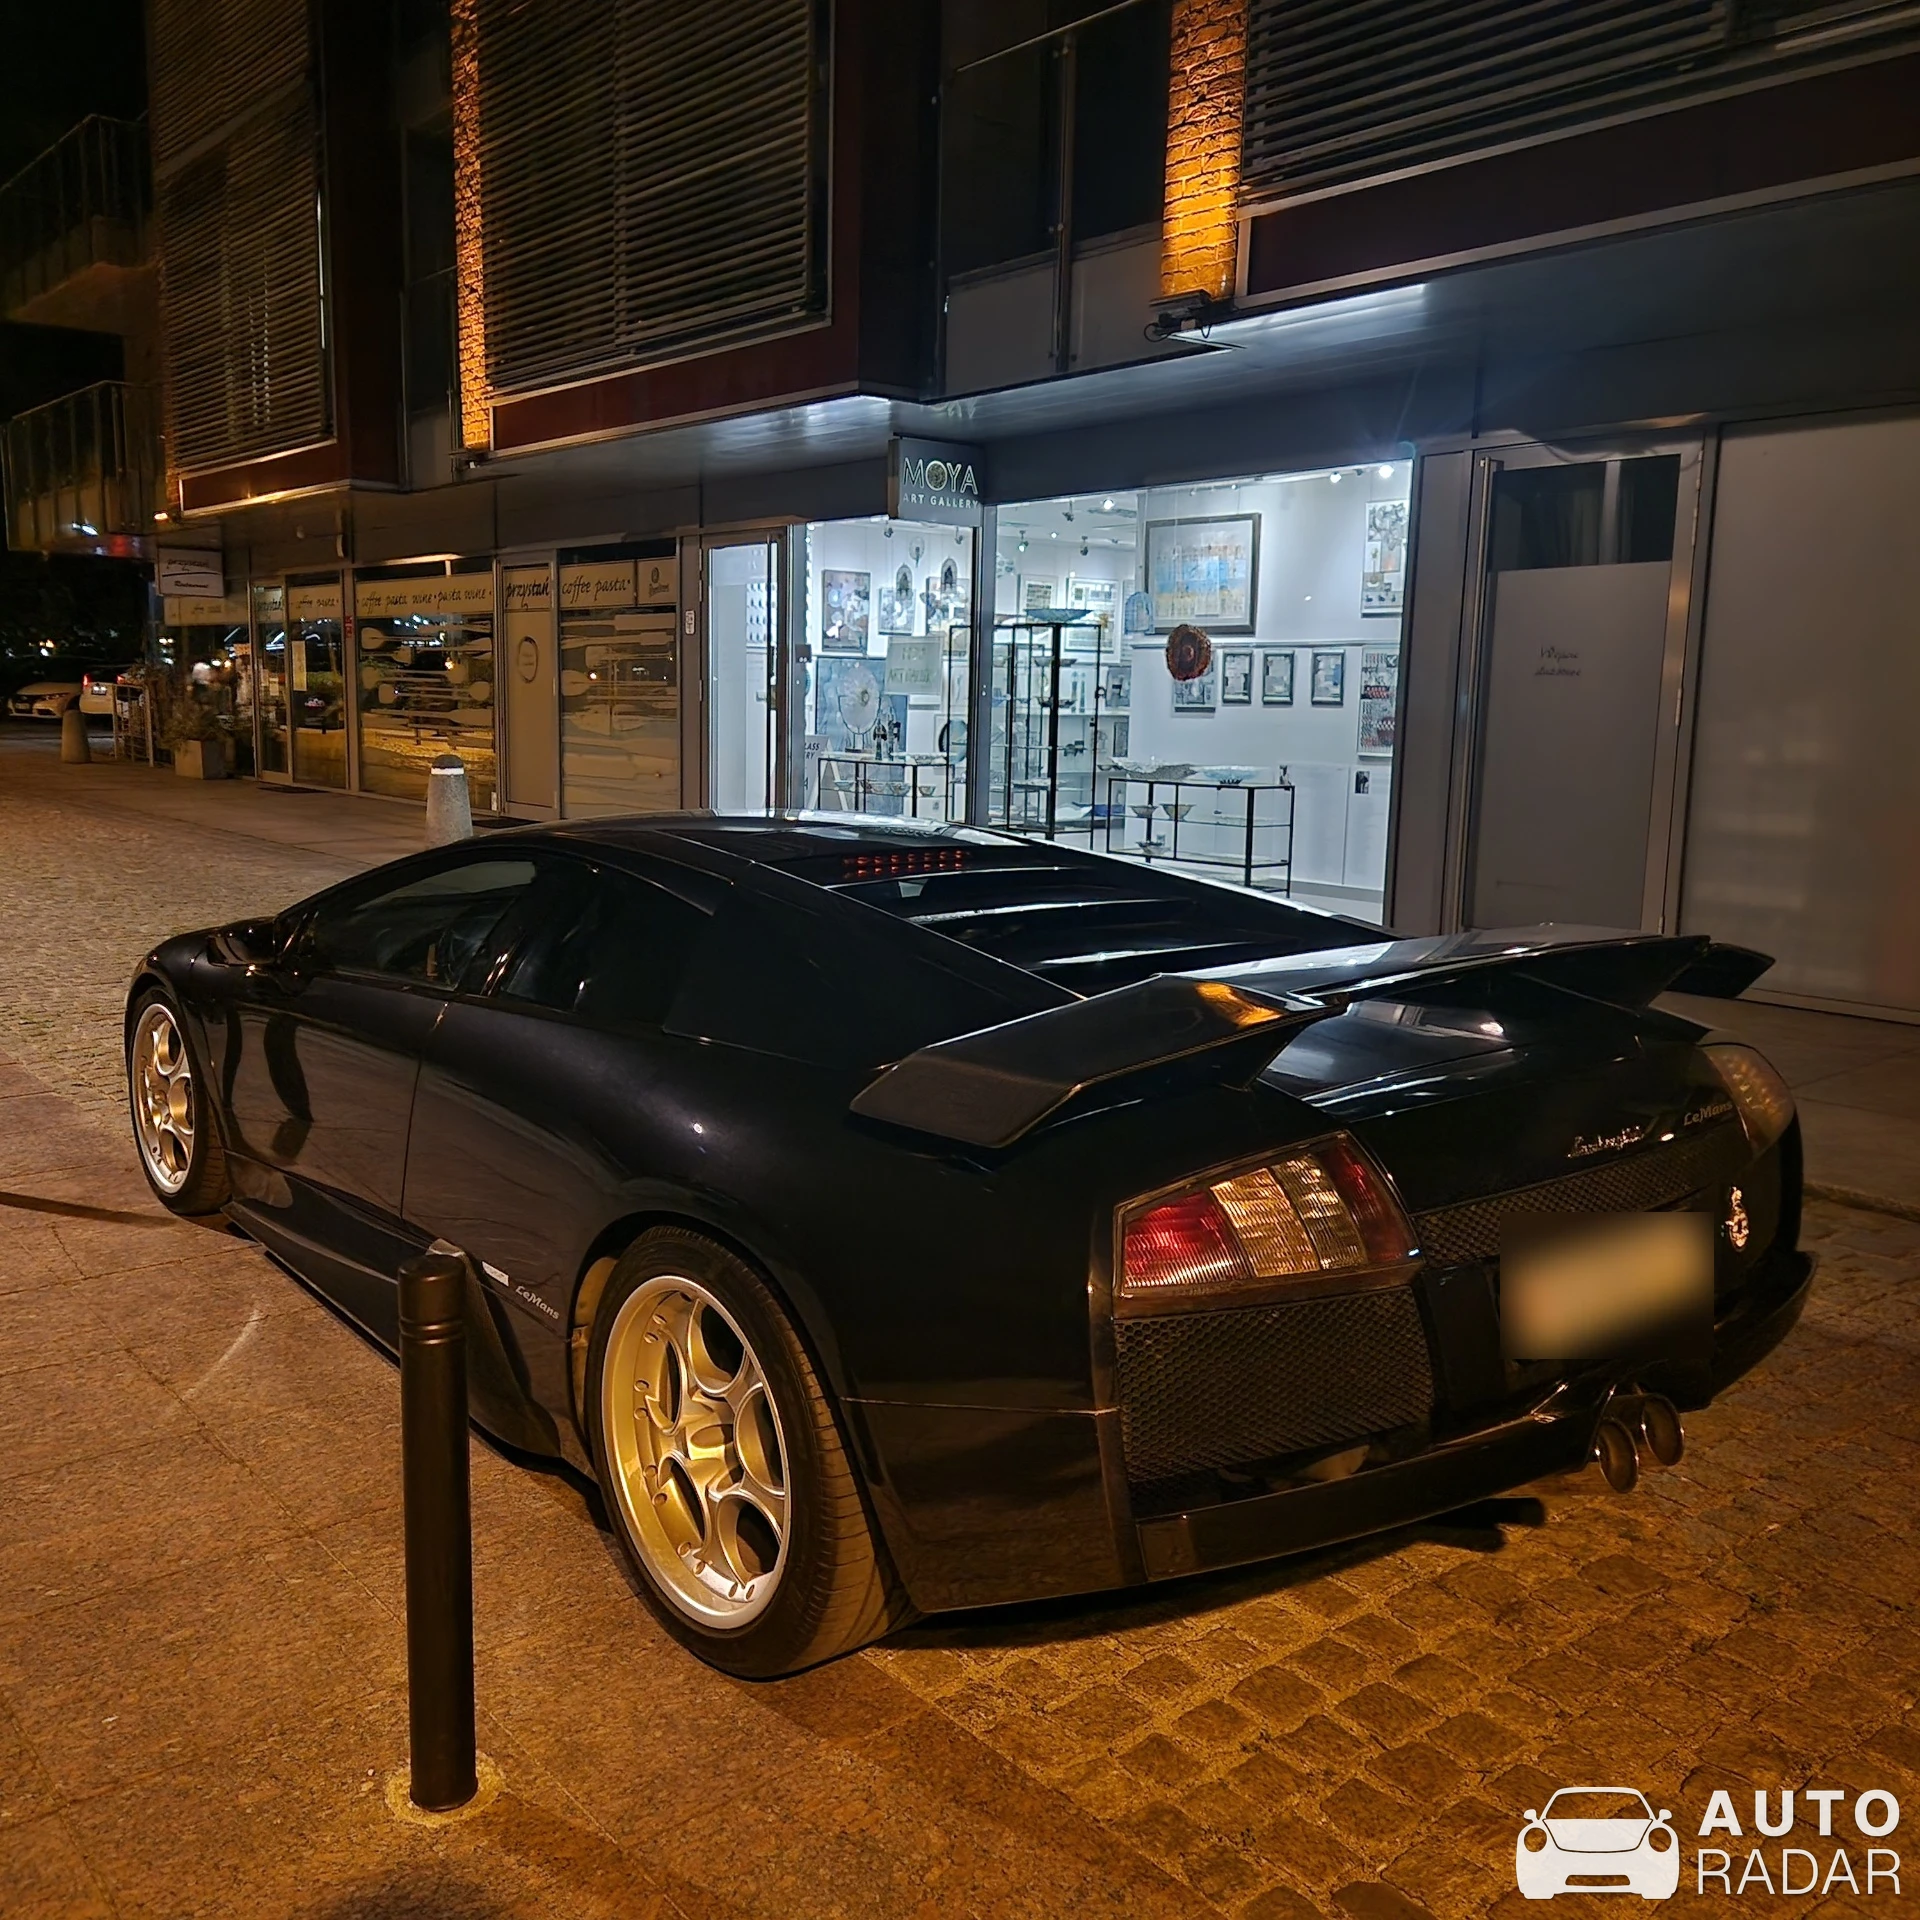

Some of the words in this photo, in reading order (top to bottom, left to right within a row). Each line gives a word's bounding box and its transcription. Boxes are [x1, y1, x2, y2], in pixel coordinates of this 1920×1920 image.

[903, 457, 978, 495] MOYA
[903, 493, 924, 504] ART
[930, 495, 979, 509] GALLERY
[361, 591, 382, 614] coffee
[385, 593, 408, 613] pasta
[436, 589, 461, 611] pasta
[505, 576, 549, 610] przystań
[561, 575, 592, 604] coffee
[595, 578, 627, 602] pasta
[1683, 1101, 1733, 1126] LeMans
[515, 1285, 560, 1320] LeMans
